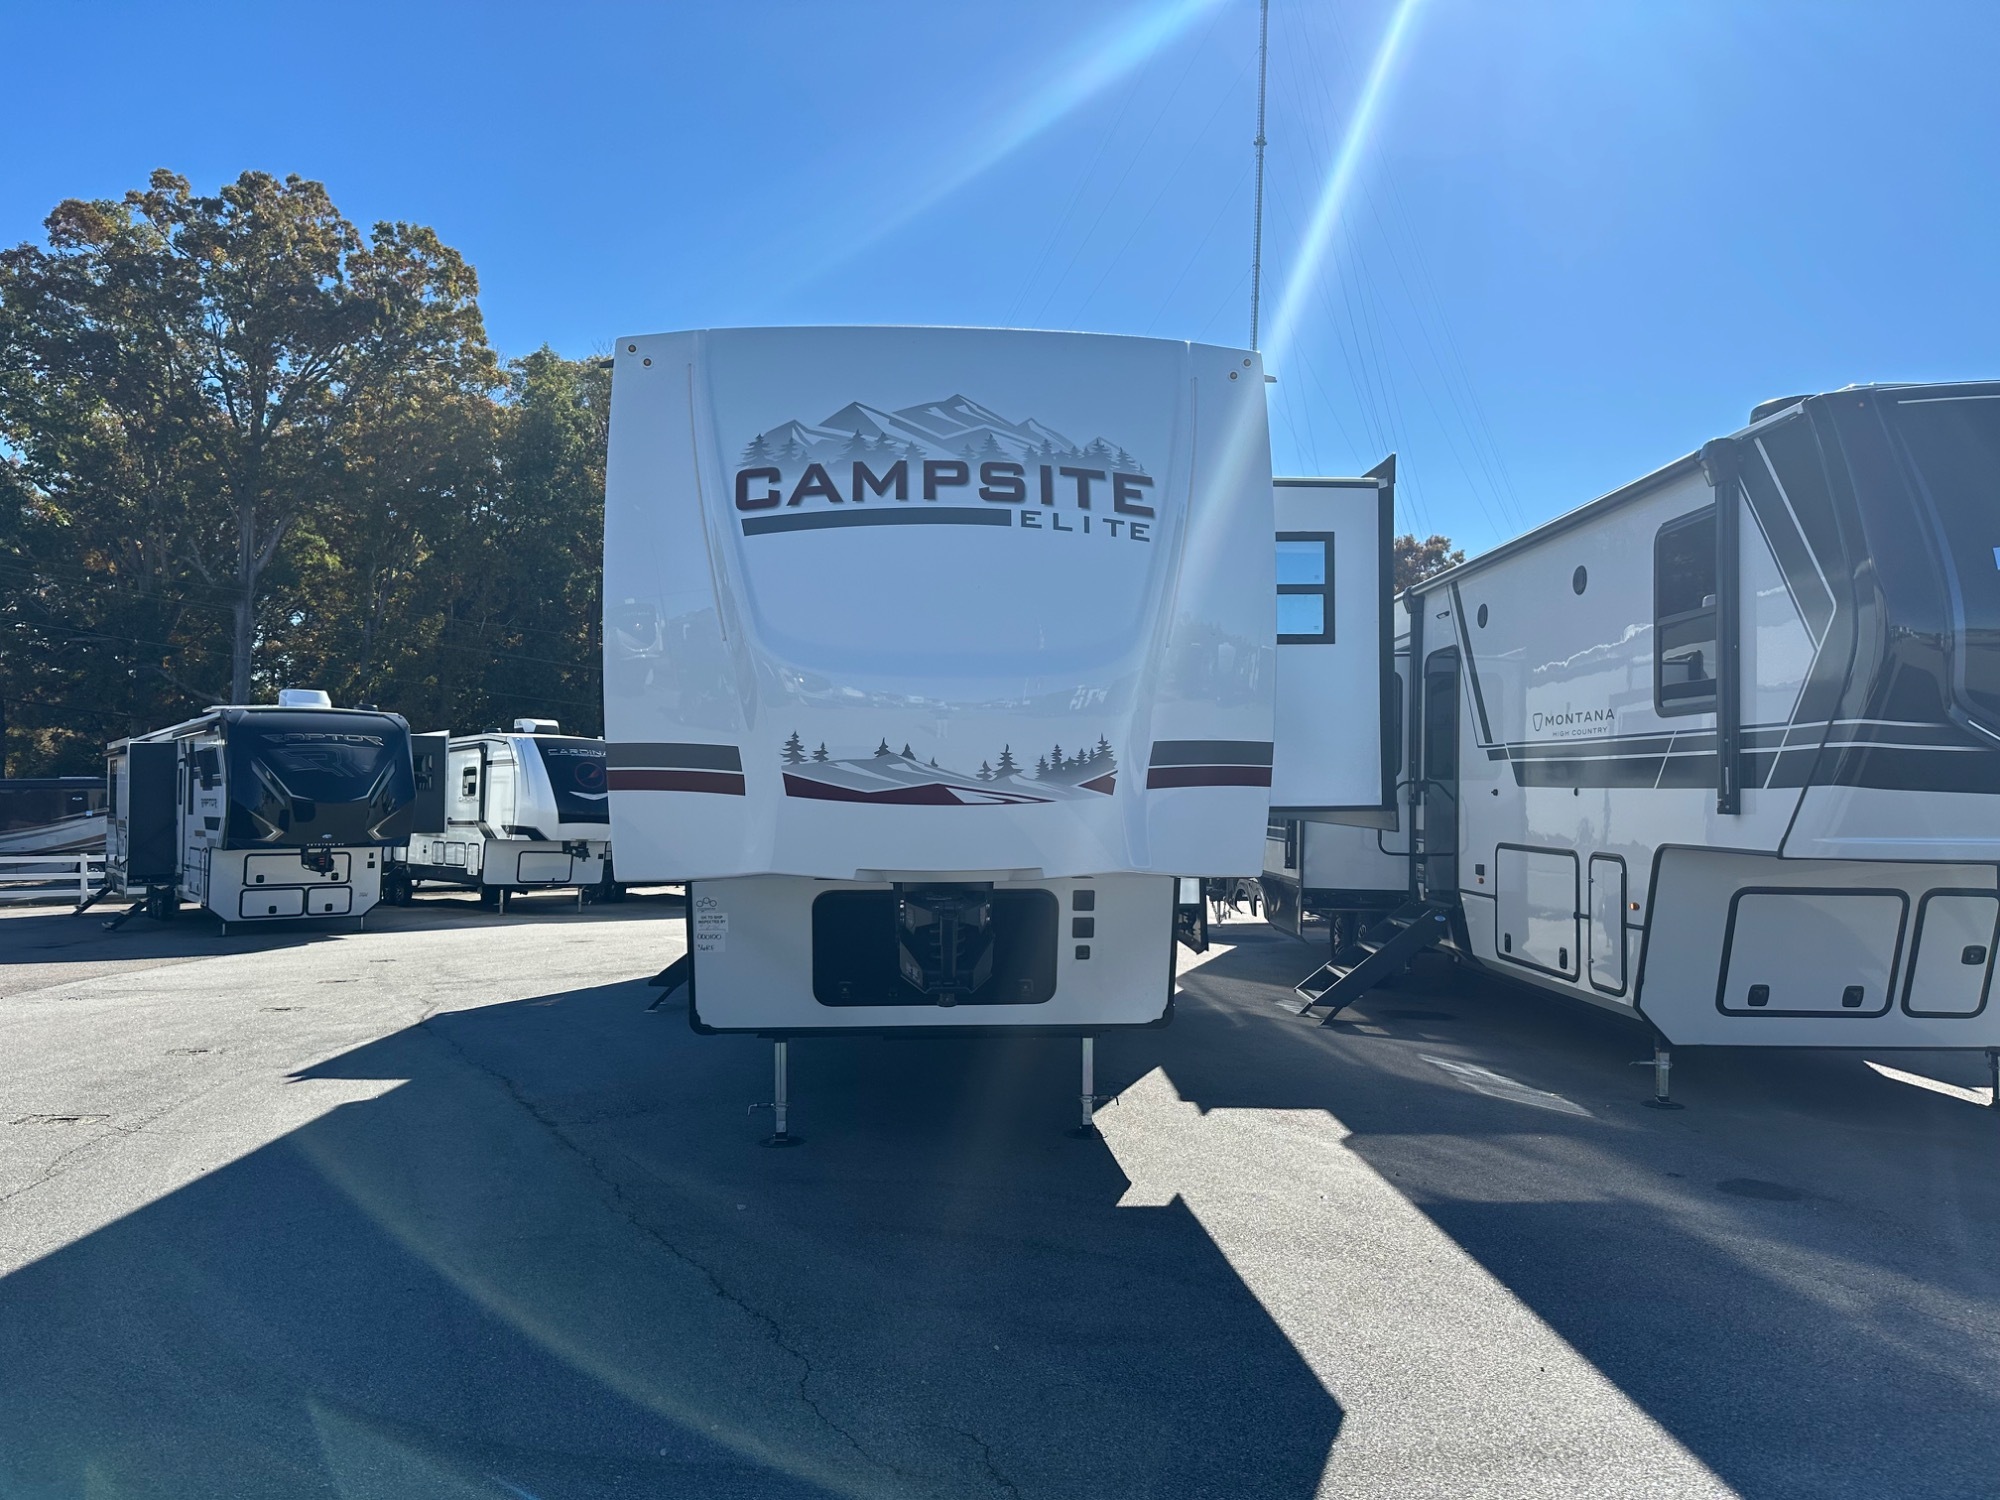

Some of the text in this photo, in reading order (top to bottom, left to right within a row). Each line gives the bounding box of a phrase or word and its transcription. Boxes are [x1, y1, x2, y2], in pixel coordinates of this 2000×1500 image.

[735, 460, 1155, 516] CAMPSITE
[1020, 510, 1151, 542] ELITE
[1545, 708, 1615, 726] MONTANA
[1571, 726, 1608, 736] COUNTRY
[260, 733, 384, 746] RAPTOR
[547, 748, 607, 757] CARDINA
